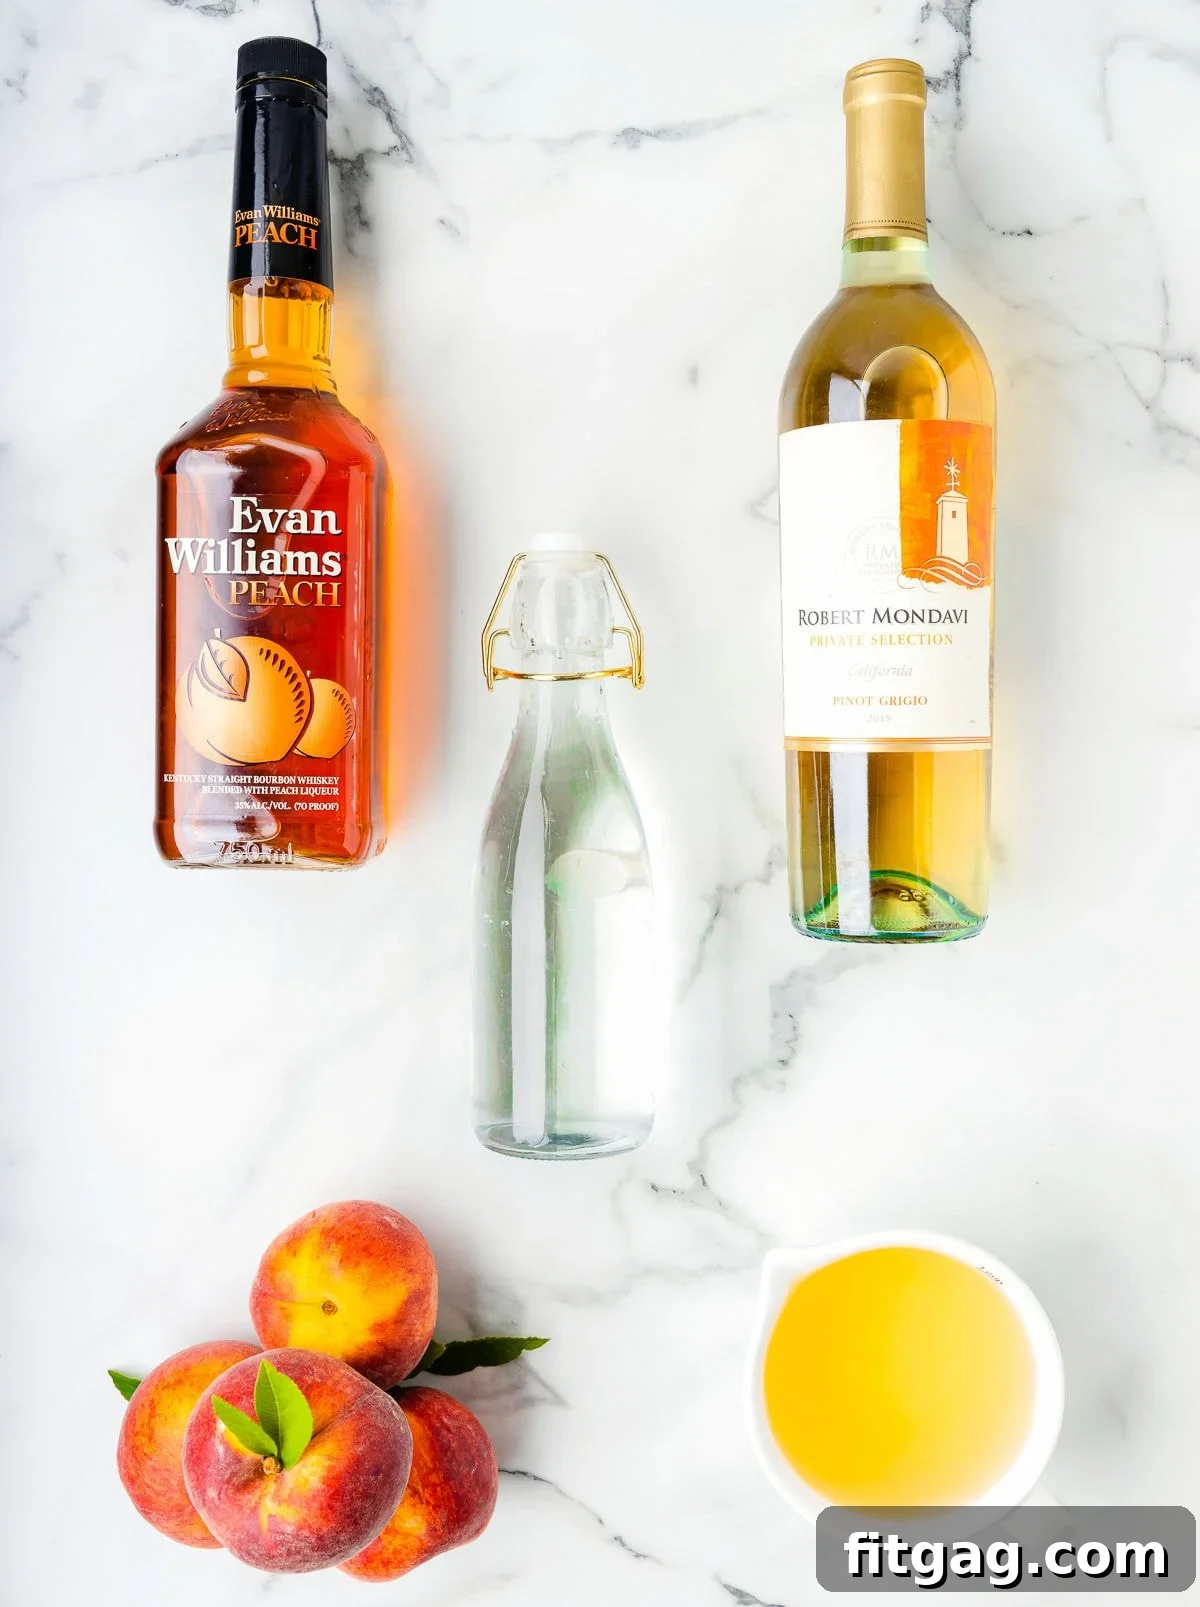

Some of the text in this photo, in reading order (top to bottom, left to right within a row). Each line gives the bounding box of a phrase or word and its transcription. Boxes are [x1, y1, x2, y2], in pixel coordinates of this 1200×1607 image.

[235, 204, 320, 227] Evan Williams
[234, 221, 318, 251] PEACH
[229, 496, 342, 534] Evan
[165, 537, 342, 576] Williams
[228, 580, 342, 607] PEACH
[798, 607, 968, 626] ROBERT MONDAVI
[810, 633, 953, 647] PRIVATE SELECTION
[847, 662, 913, 682] California
[832, 695, 928, 706] PINOT GRIGIO
[163, 773, 340, 785] KENTUCKY STRAIGHT BOURBON WHISKEY
[202, 785, 340, 797] BLENDED WITH PEACH LIQUEUR
[294, 802, 308, 811] (70
[308, 802, 340, 811] PROOF)
